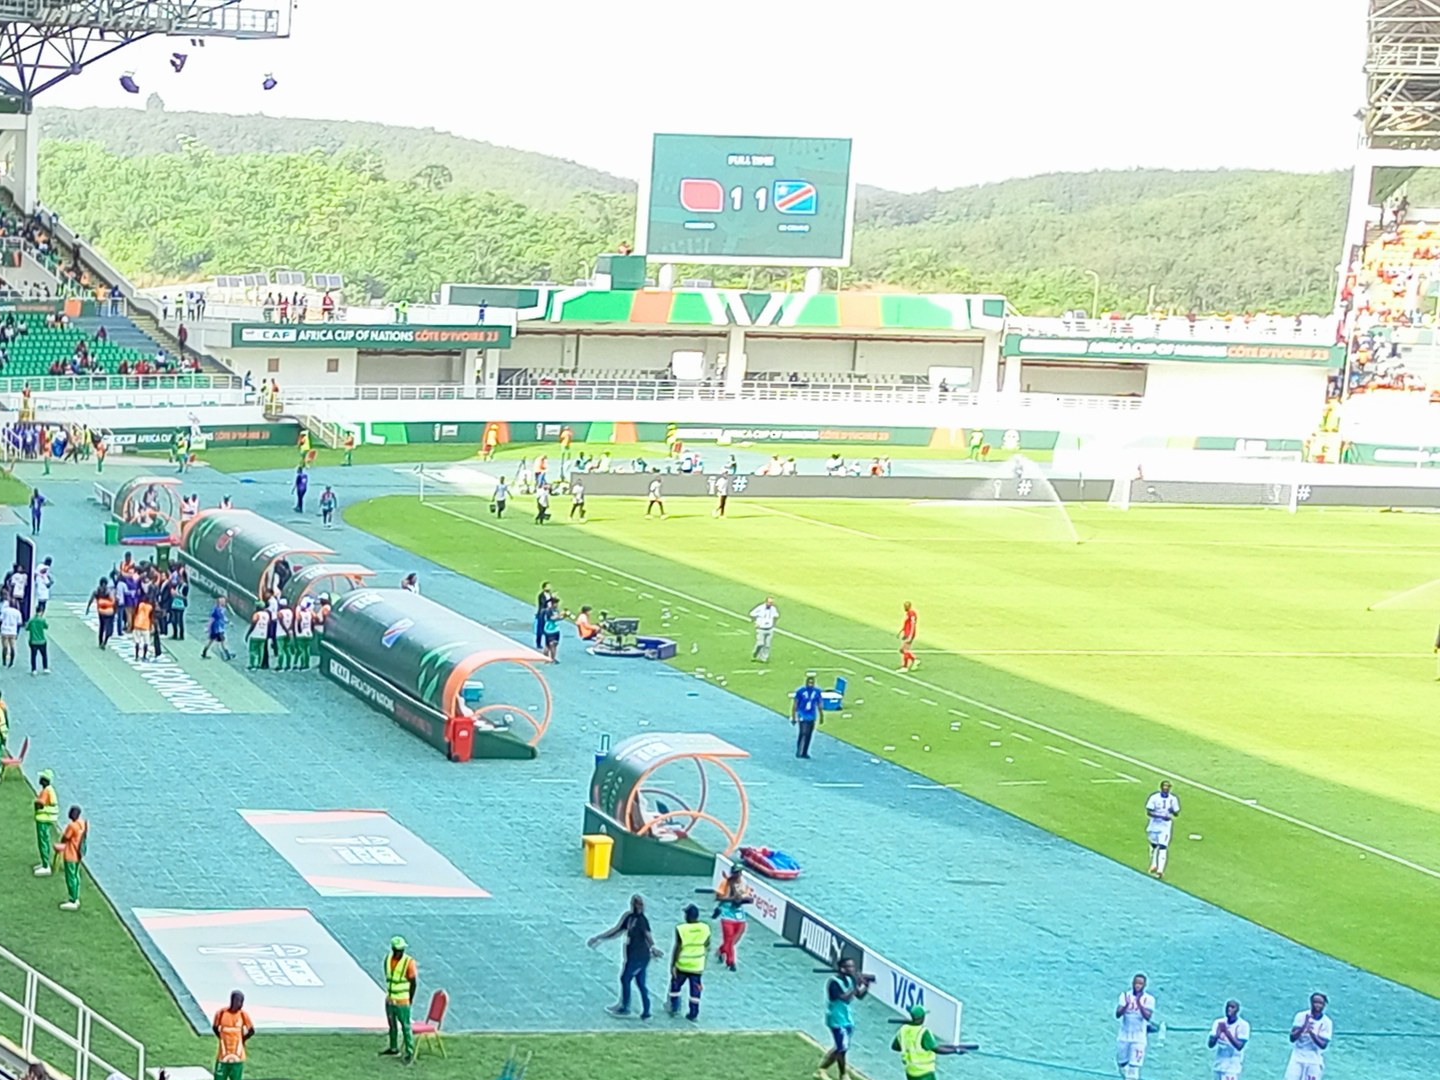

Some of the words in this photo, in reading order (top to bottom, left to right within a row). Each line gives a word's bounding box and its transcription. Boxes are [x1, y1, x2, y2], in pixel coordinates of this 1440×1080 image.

[731, 186, 742, 210] 1
[756, 187, 767, 211] 1
[263, 331, 291, 339] CAF
[298, 330, 333, 341] AFRICA
[334, 330, 354, 341] CUP
[355, 330, 370, 341] OF
[370, 330, 414, 342] NATIONS
[799, 915, 833, 964] PUMA
[891, 970, 926, 1012] VISA
